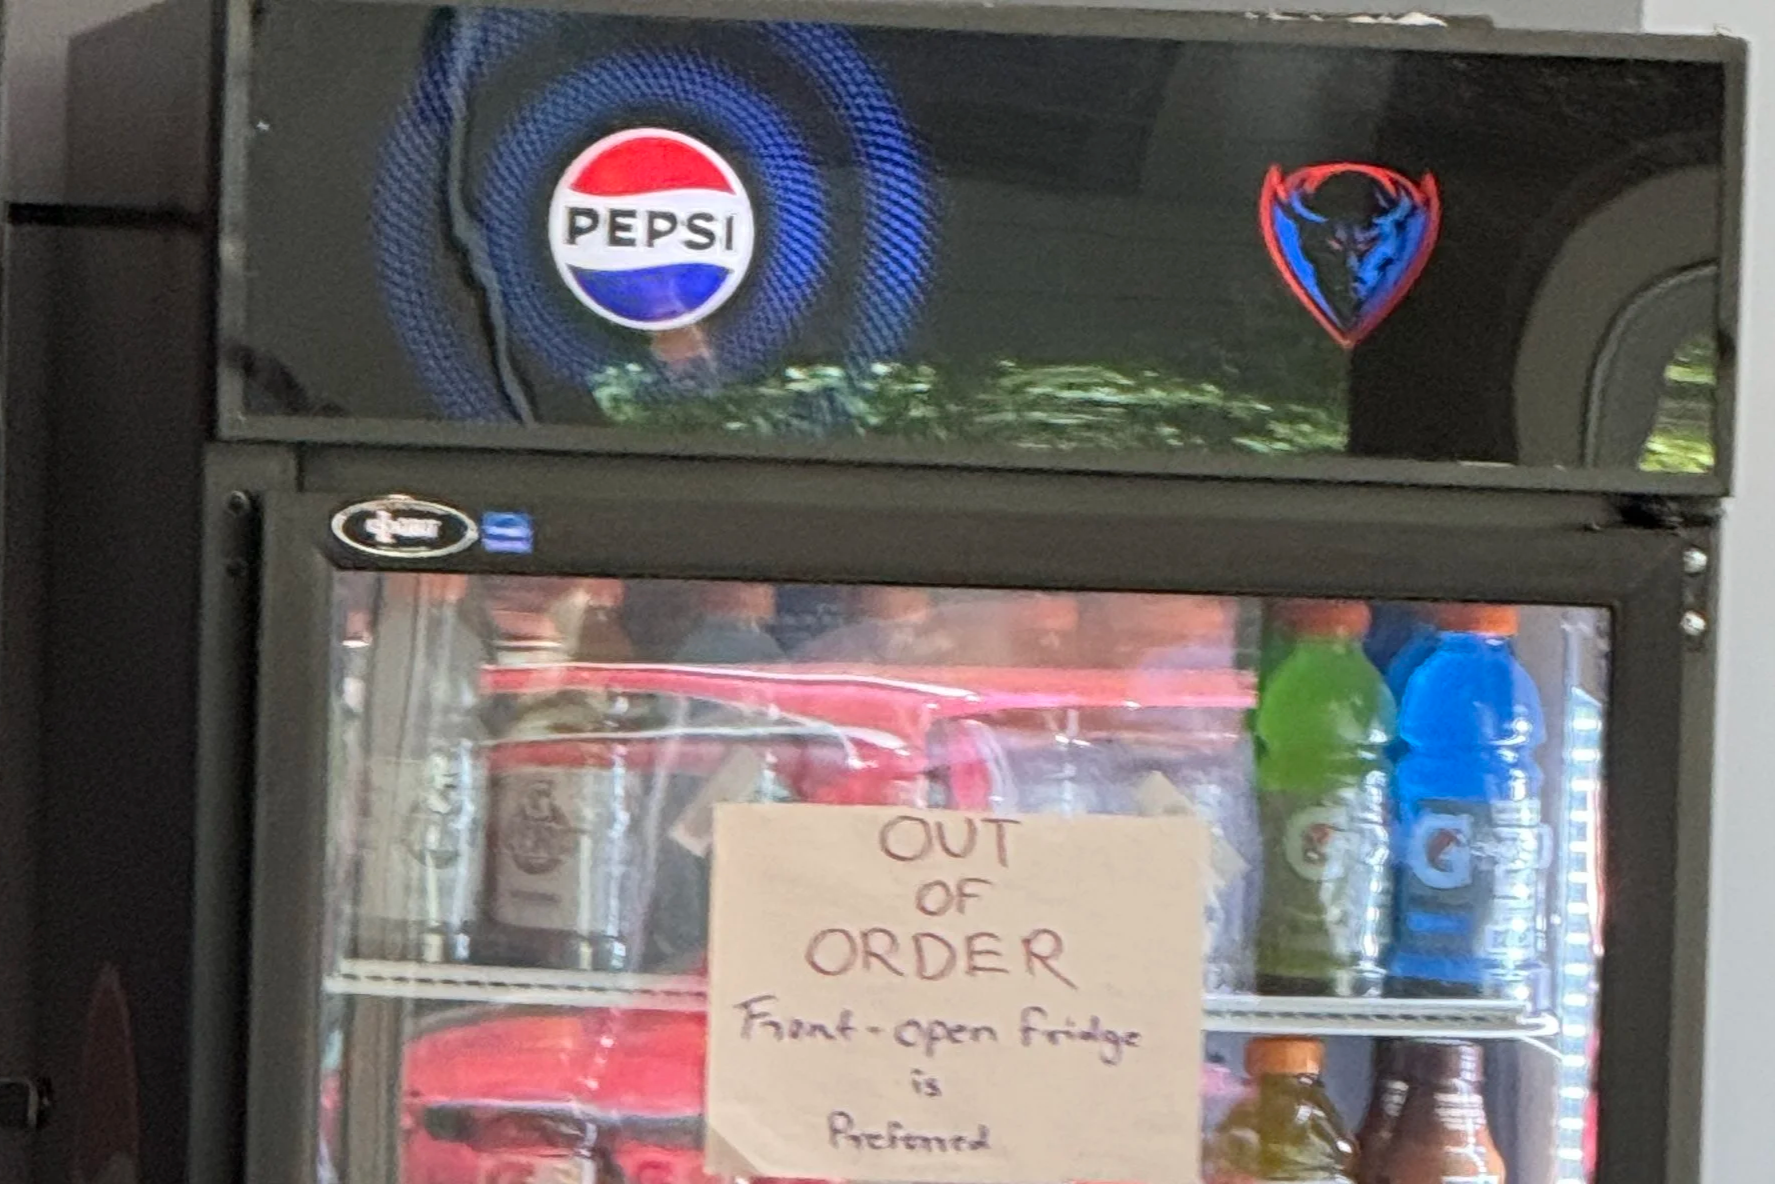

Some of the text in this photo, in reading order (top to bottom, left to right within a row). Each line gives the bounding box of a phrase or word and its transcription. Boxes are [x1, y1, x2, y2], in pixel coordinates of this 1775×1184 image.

[565, 205, 734, 251] PEPSI
[878, 815, 1022, 868] OUT
[1410, 812, 1474, 890] G
[915, 877, 992, 917] OF
[804, 927, 1079, 990] ORDER
[910, 1068, 942, 1097] is
[827, 1110, 992, 1153] Preferred
